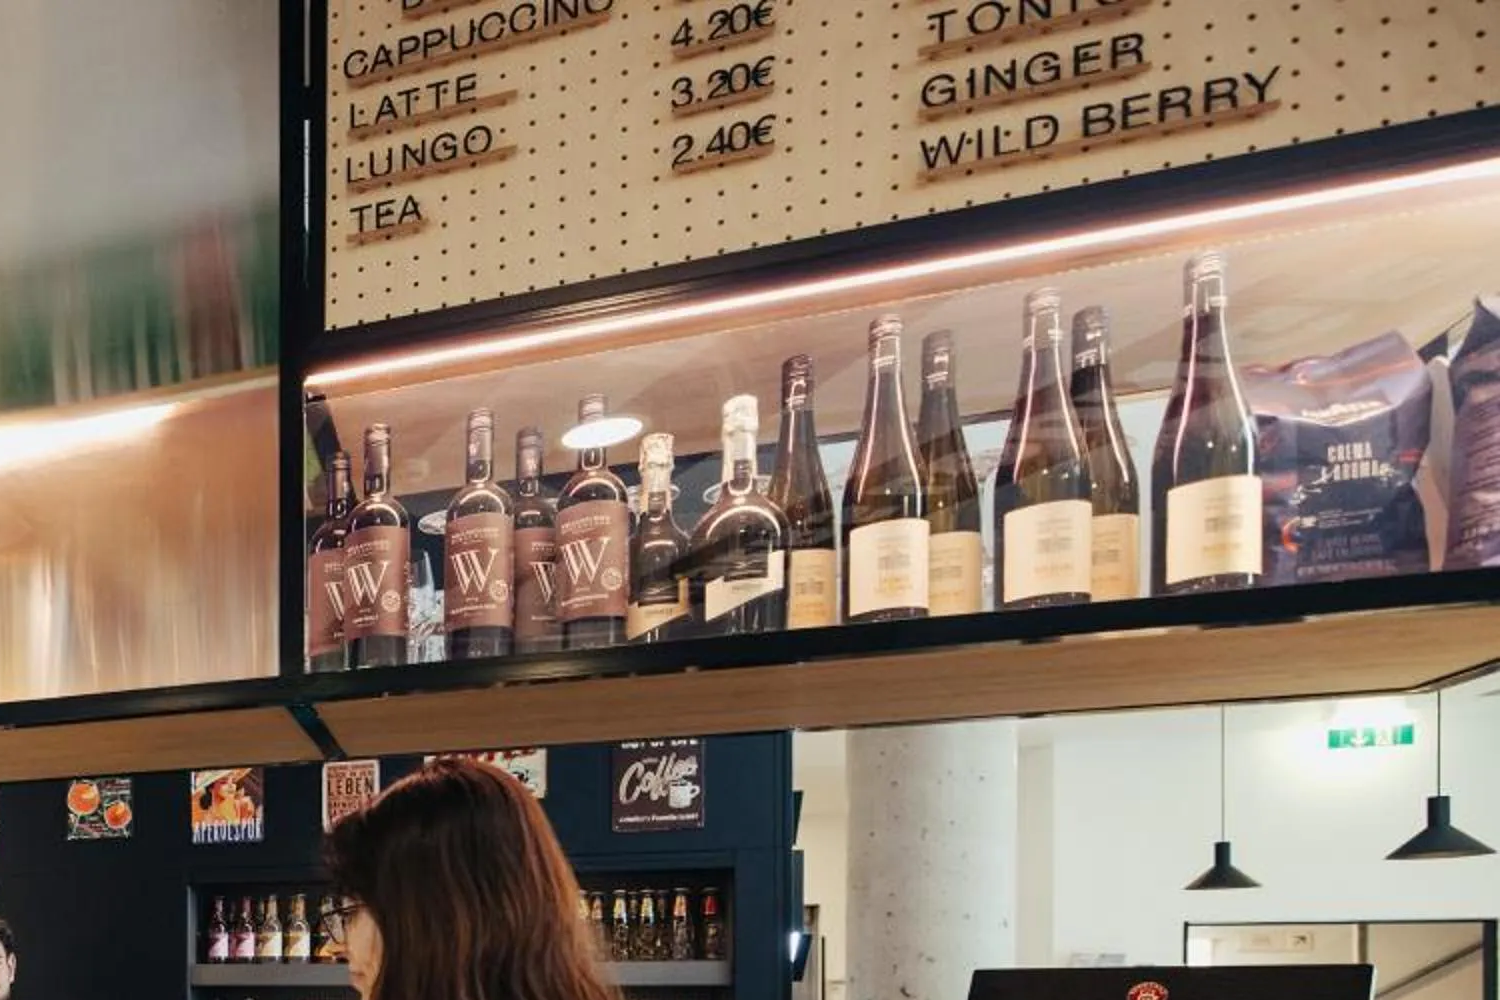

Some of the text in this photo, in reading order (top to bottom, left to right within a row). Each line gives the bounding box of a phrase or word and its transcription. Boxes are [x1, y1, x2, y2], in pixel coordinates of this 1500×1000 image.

[671, 0, 775, 48] 4.20€
[927, 0, 1128, 43] TON
[670, 56, 776, 111] 3.20€
[921, 32, 1146, 108] GINGER
[349, 73, 478, 129] LATTE
[920, 65, 1281, 169] WILD BERRY
[346, 125, 493, 183] LUNGO
[671, 114, 777, 170] 2.40€
[350, 195, 422, 234] TEA
